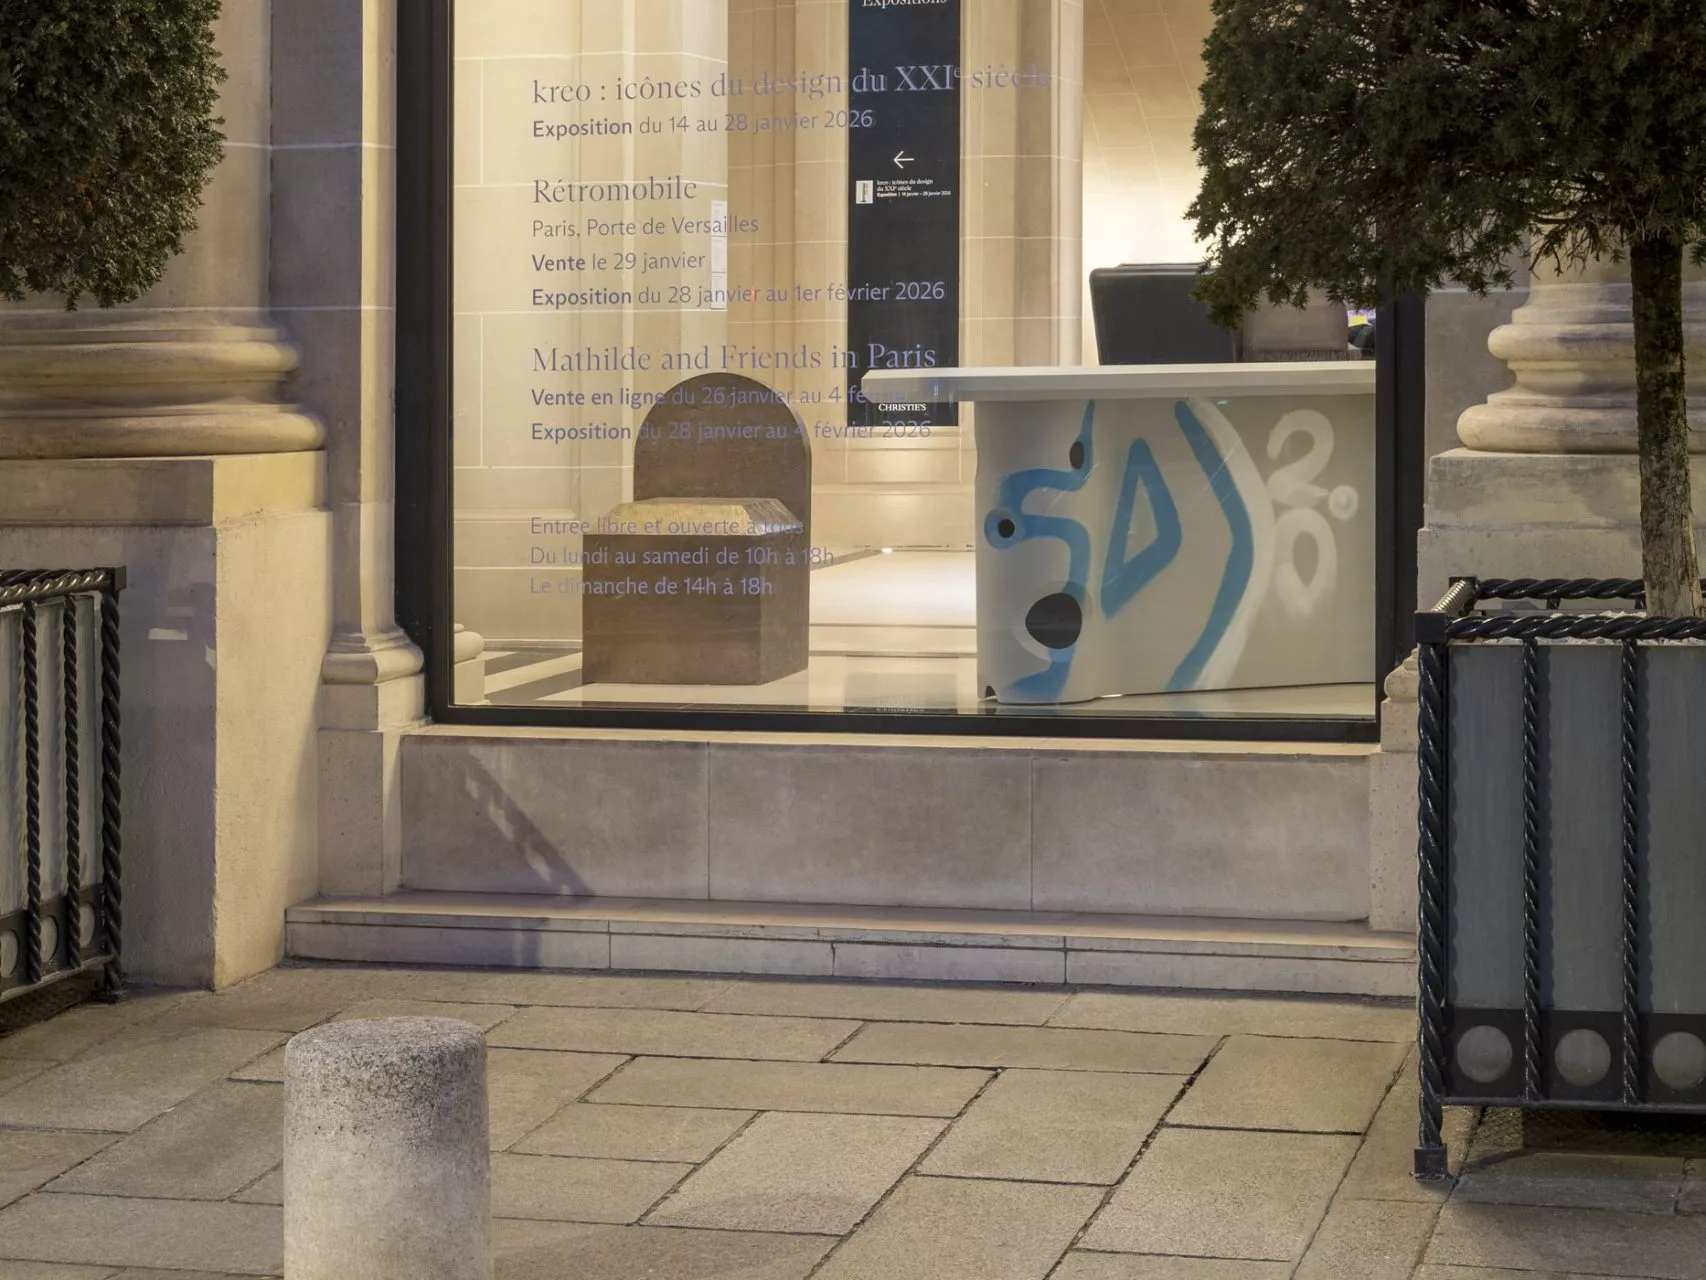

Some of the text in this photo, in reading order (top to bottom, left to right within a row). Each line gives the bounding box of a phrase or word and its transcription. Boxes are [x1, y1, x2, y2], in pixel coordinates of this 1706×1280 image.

[533, 79, 591, 104] kreo
[600, 85, 606, 101] :
[616, 76, 701, 102] icônes
[711, 72, 745, 97] du
[753, 70, 842, 100] design
[852, 68, 887, 93] du
[971, 61, 1051, 89] siècle
[533, 109, 874, 140] Exposition du 14 au 28 janvier 2026
[533, 175, 697, 204] Rétromobile
[532, 216, 759, 239] Paris, Porte de Versailles
[532, 251, 706, 274] Vente le 29 janvier
[532, 281, 945, 309] Exposition du 28 janvier au 1er février 2026
[532, 343, 936, 371] Mathilde and Friends in Paris
[531, 388, 585, 406] Vente
[591, 392, 613, 405] en
[620, 387, 666, 409] ligne
[672, 387, 695, 404] du
[702, 386, 725, 404] 26
[730, 386, 793, 407] janvier
[799, 390, 822, 404] au
[828, 386, 843, 404] 4
[878, 403, 927, 412] CHRISTIE'S
[531, 419, 932, 444] Exposition du 28 janvier au 4 février 2026
[597, 515, 637, 534] libre
[644, 518, 663, 534] et
[668, 519, 740, 534] ouverte
[531, 546, 834, 565] Du lundi au samedi de 10h à 18h
[531, 575, 772, 595] Le dimanche de 14h à 18h
